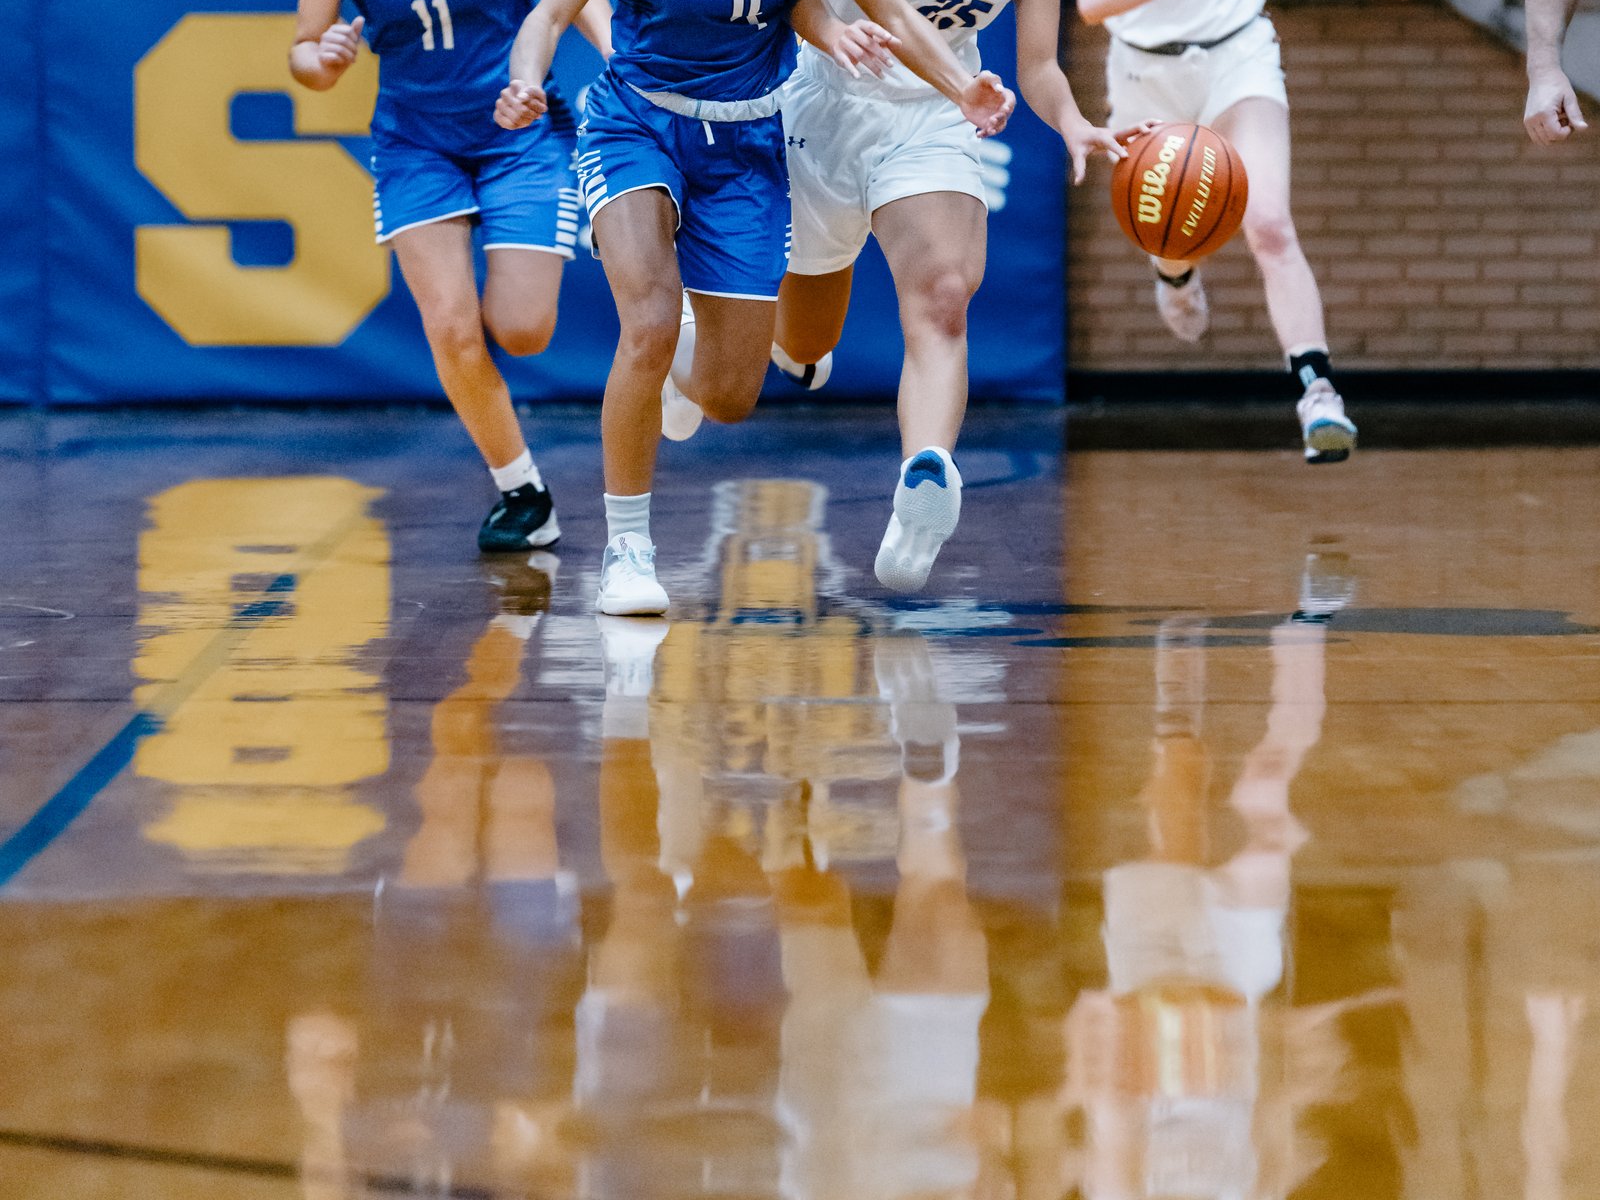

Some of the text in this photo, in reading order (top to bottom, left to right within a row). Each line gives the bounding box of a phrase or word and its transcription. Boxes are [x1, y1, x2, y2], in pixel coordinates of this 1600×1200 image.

[134, 12, 392, 347] S
[1137, 134, 1186, 225] Wilson
[1180, 145, 1217, 238] EVOLUTION
